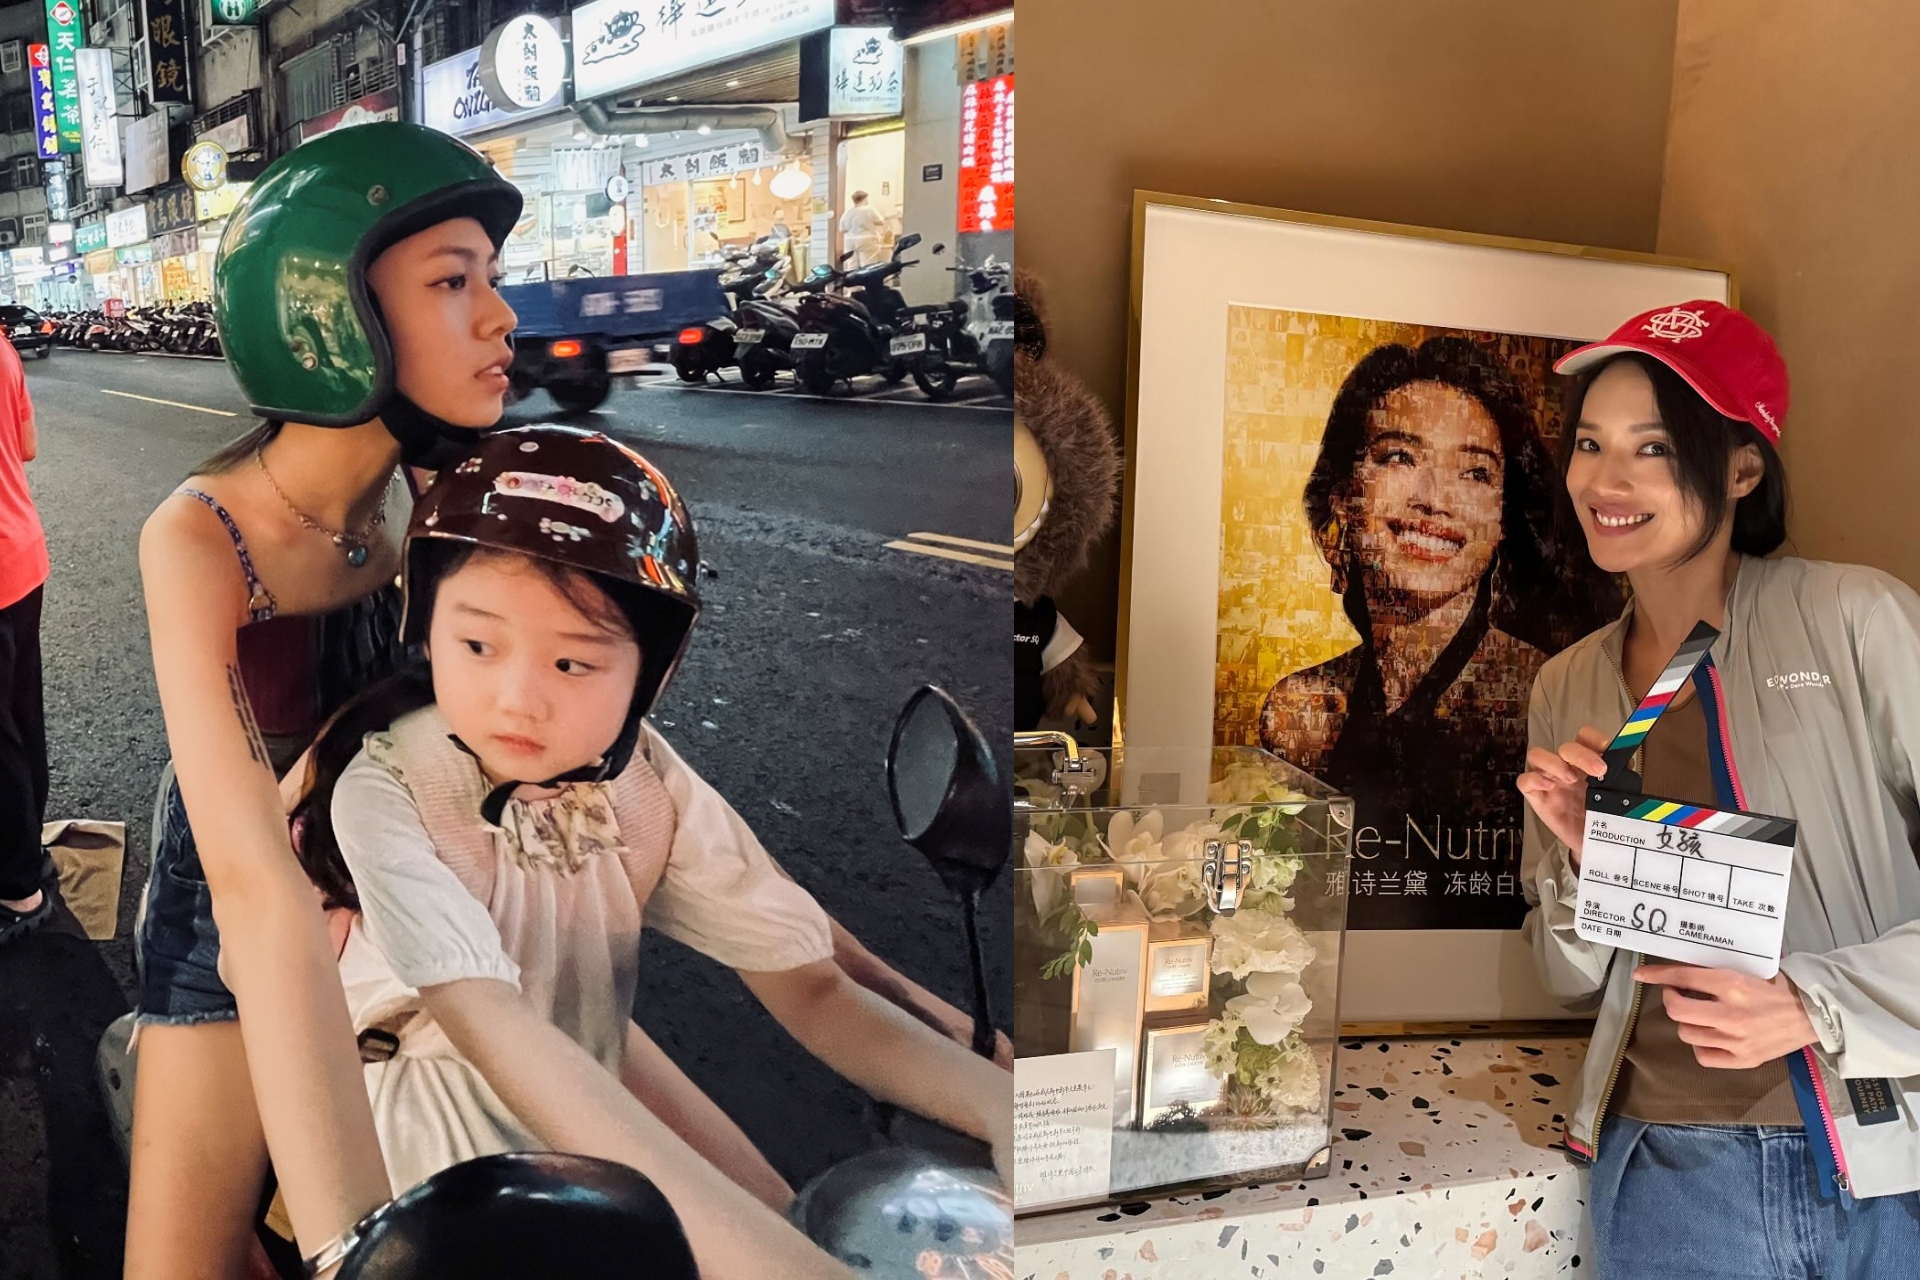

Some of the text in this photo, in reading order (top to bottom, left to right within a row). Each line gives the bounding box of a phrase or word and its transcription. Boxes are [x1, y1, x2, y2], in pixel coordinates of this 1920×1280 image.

[152, 0, 184, 92] 眼鏡
[55, 32, 80, 125] 天仁茗茶
[1592, 819, 1608, 830] 片名
[1324, 813, 1524, 860] Re-Nutri
[1590, 829, 1646, 846] PRODUCTION
[1656, 824, 1705, 859] 女孩
[1324, 870, 1524, 897] 雅诗兰黛 冻龄白
[1589, 869, 1610, 880] ROLL
[1633, 878, 1661, 891] SCENE
[1682, 887, 1706, 899] SHOT
[1732, 897, 1755, 908] TAKE
[1583, 907, 1626, 923] DIRECTOR
[1631, 902, 1667, 933] SQ
[1581, 922, 1622, 938] DATE 日期
[1679, 928, 1734, 946] CAMERAMAN
[1854, 1079, 1872, 1114] OURNEY
[1867, 1090, 1879, 1113] PATH
[1872, 1078, 1888, 1111] SSIONS
